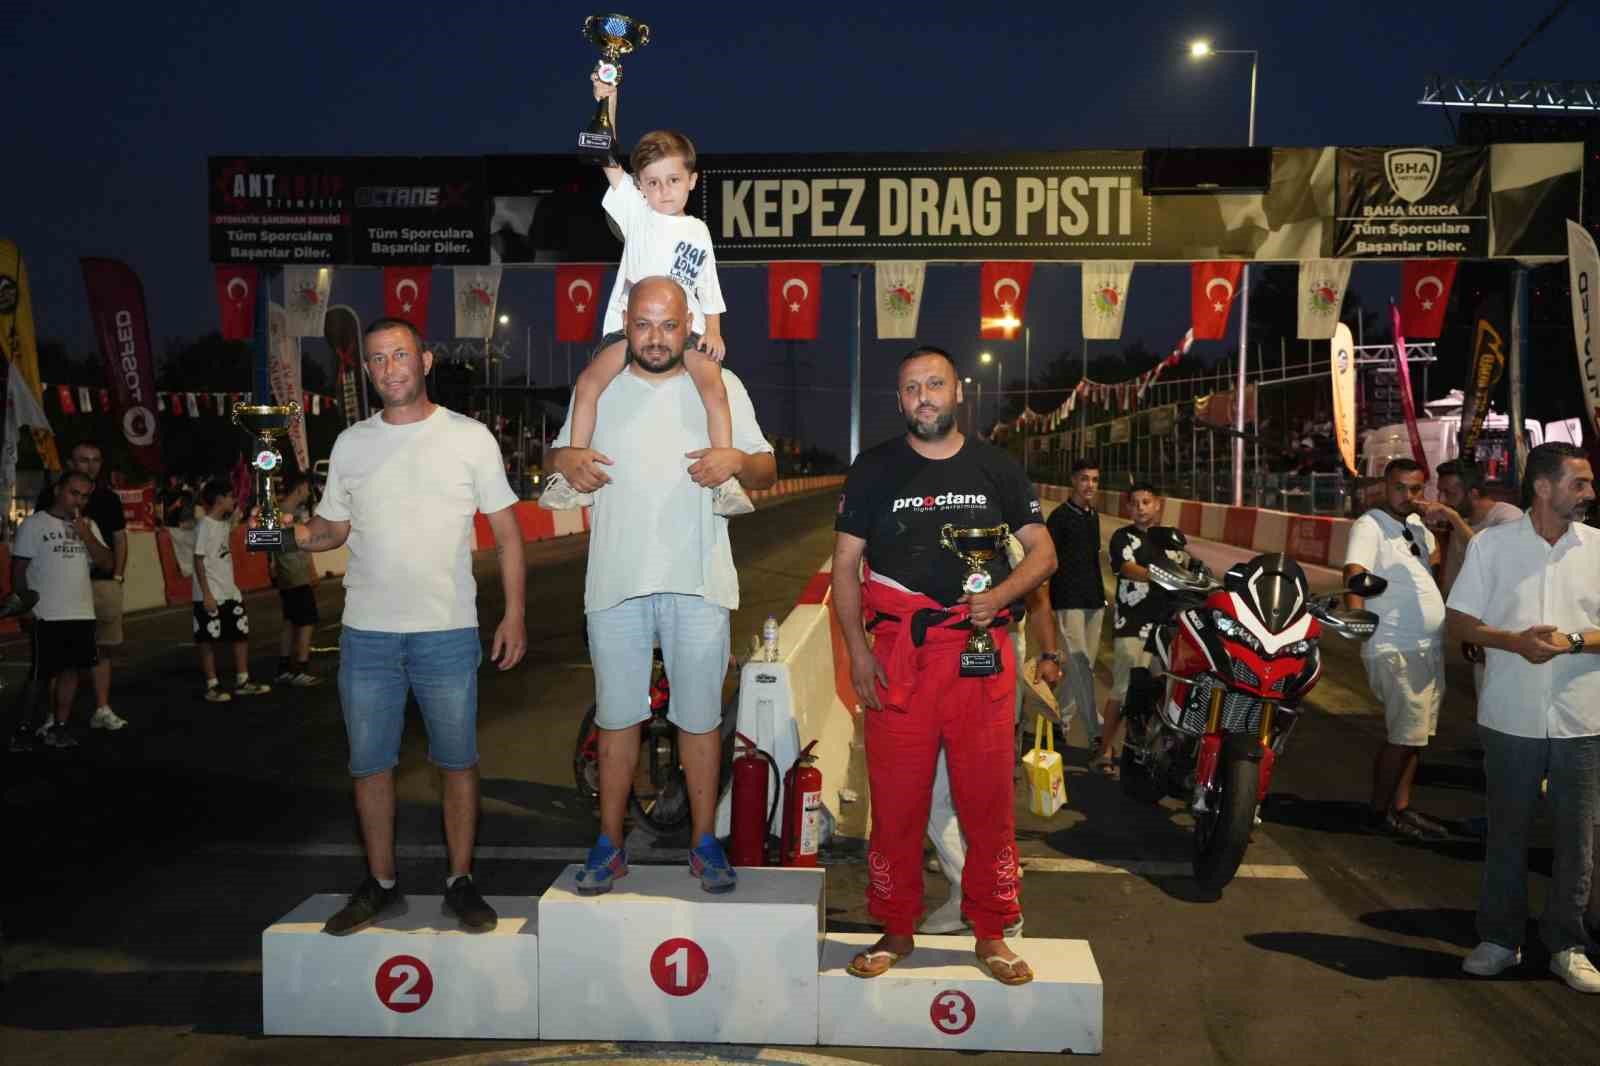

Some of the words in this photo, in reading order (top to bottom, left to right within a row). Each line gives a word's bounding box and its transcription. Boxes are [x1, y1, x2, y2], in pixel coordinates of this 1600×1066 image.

[1394, 163, 1430, 174] BHA
[722, 177, 866, 238] KEPEZ
[879, 176, 1002, 236] DRAG
[1363, 206, 1405, 216] BAHA
[227, 230, 257, 241] Tüm
[260, 230, 334, 243] Sporculara
[368, 227, 398, 239] Tüm
[401, 228, 474, 242] Sporculara
[1353, 222, 1387, 235] Tüm
[1390, 222, 1471, 237] Sporculara
[435, 242, 470, 254] Diler.
[892, 492, 987, 512] prooctane
[664, 947, 689, 987] 1
[388, 966, 421, 1005] 2
[940, 995, 966, 1031] 3
